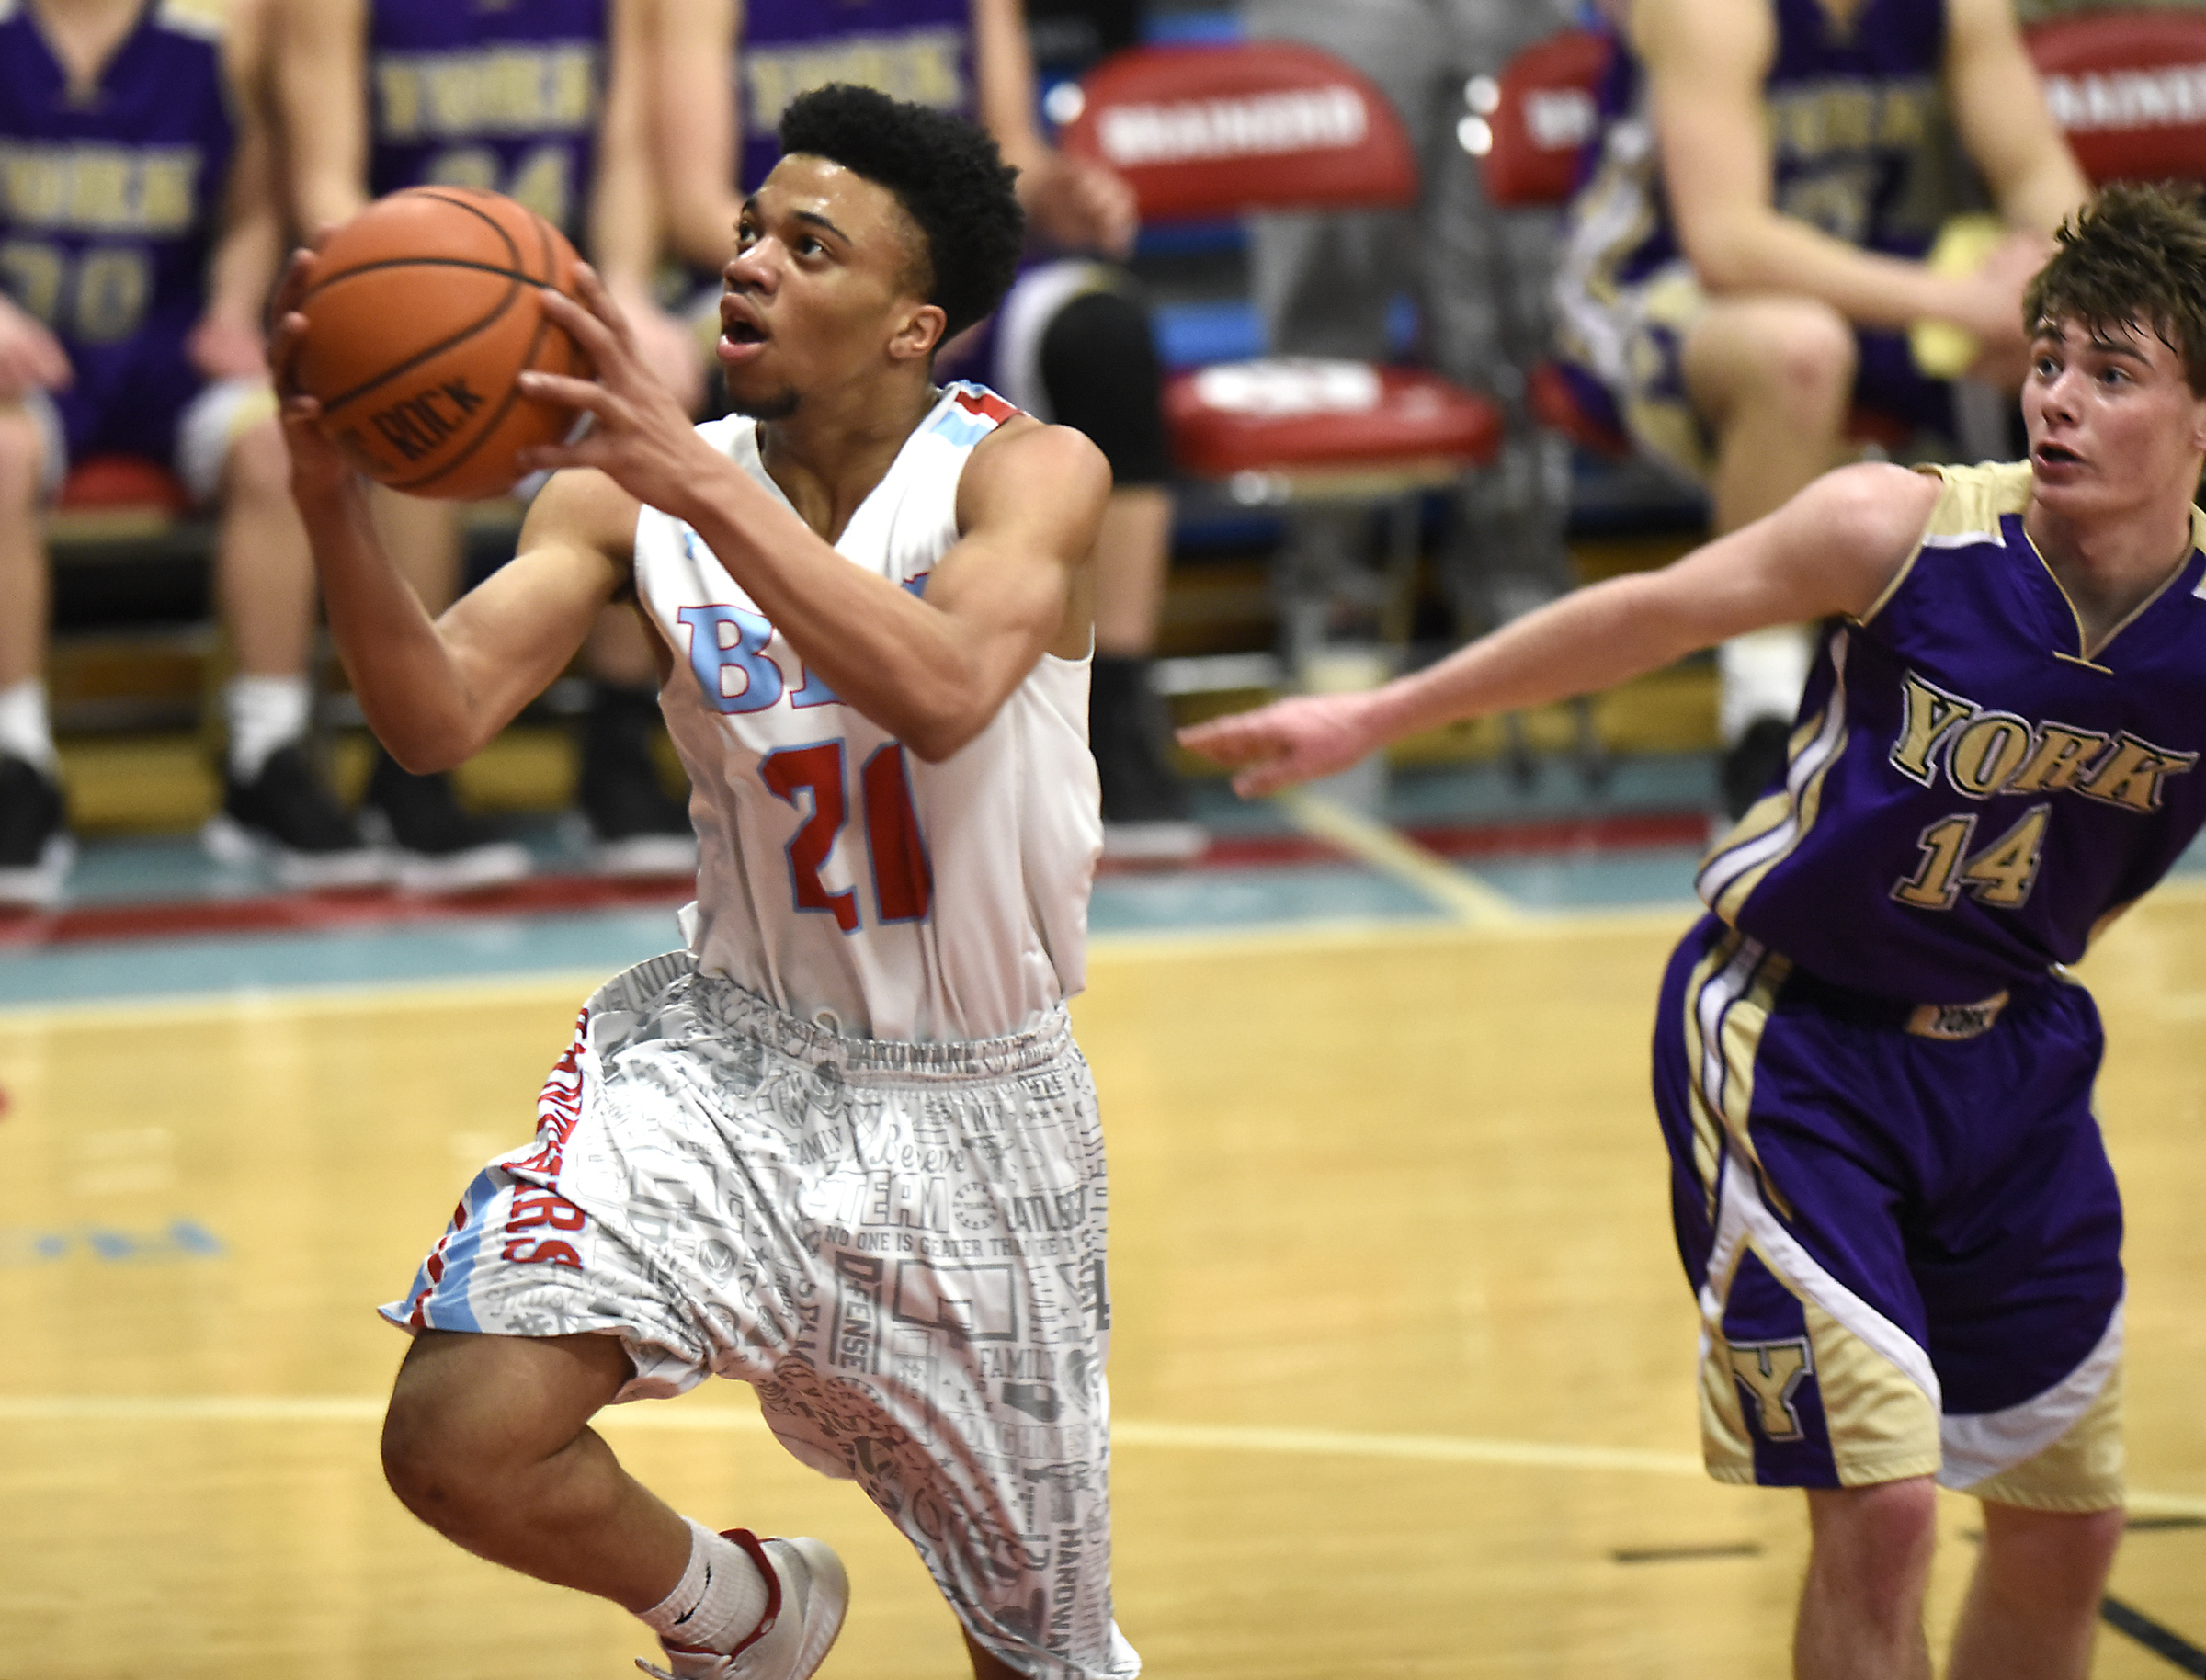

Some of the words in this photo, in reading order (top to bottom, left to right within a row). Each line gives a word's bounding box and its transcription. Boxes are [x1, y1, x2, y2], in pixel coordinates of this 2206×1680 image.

[370, 375, 484, 460] ROCK
[1890, 668, 2200, 814] YORK
[756, 737, 936, 936] 21
[1890, 803, 2053, 910] 14
[821, 1169, 950, 1233] TEAM
[827, 1226, 849, 1246] NO
[857, 1232, 890, 1252] ONE
[896, 1233, 914, 1253] IS
[1728, 1335, 1813, 1442] Y
